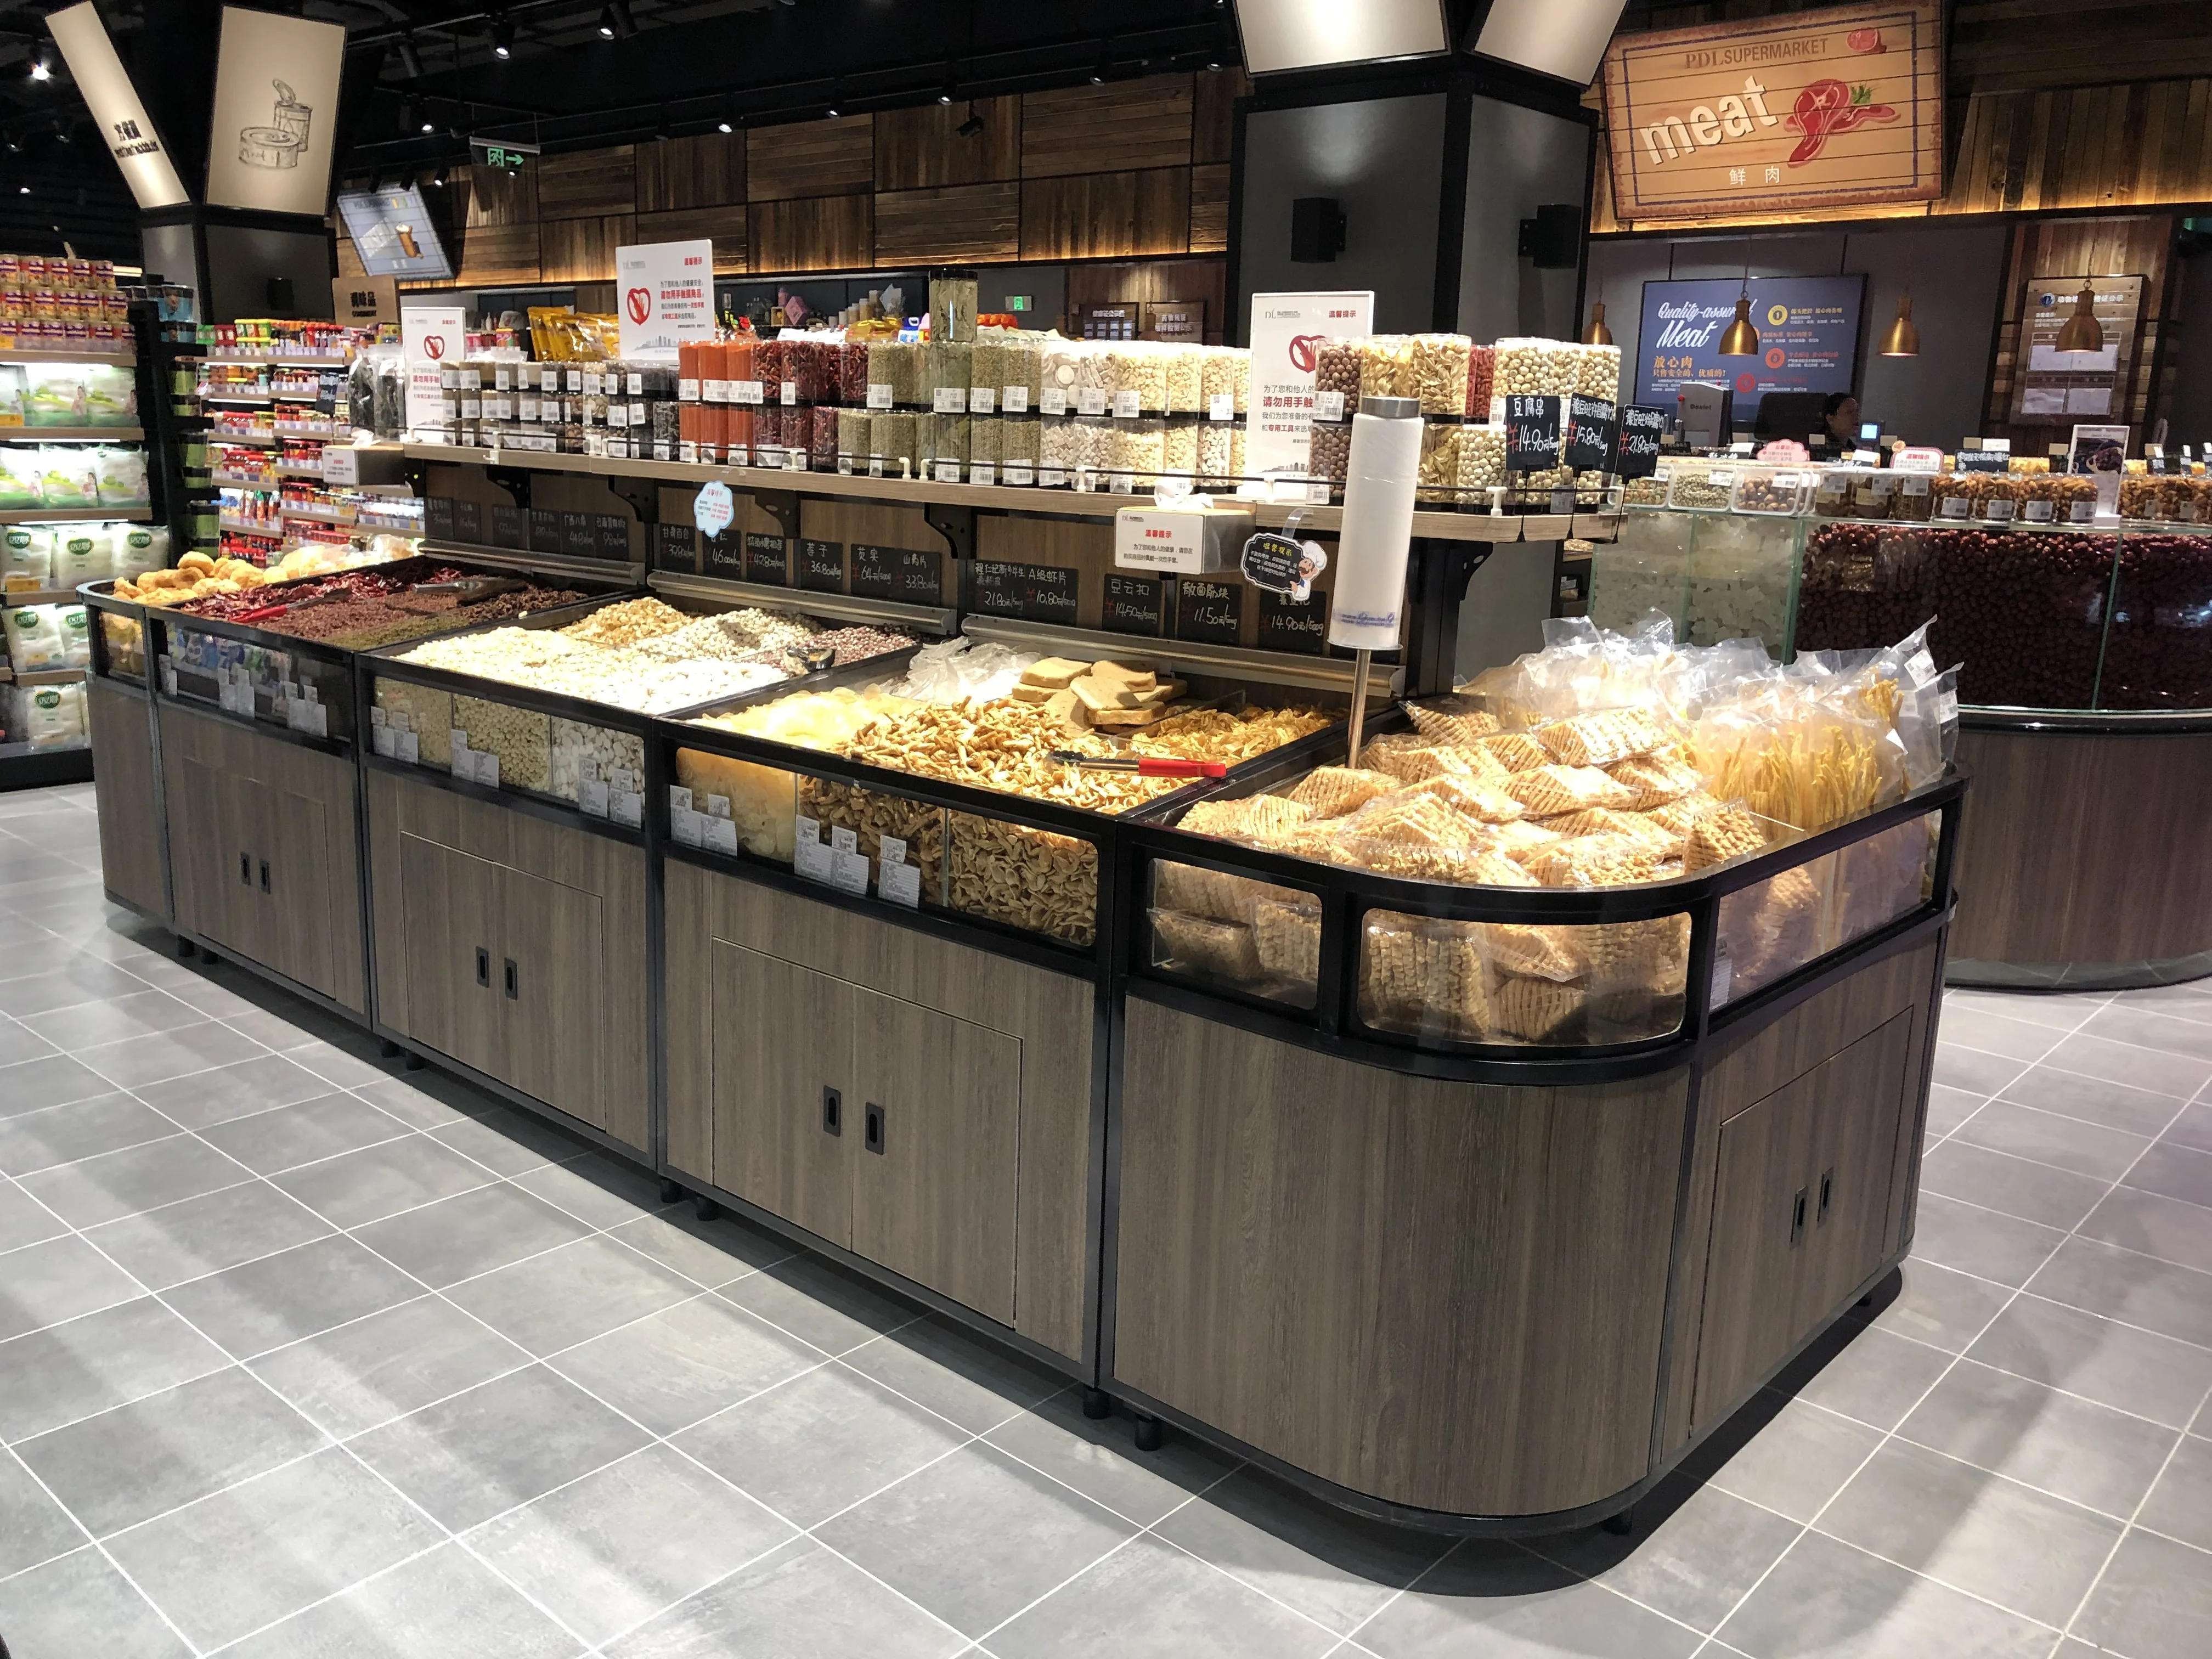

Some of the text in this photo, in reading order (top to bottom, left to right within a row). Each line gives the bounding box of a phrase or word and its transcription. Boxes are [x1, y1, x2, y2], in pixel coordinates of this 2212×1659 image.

[1640, 75, 1779, 165] meat
[1728, 165, 1781, 185] 鲜肉
[1329, 310, 1356, 318] 温馨提示
[1656, 320, 1718, 348] Meat
[1654, 356, 1693, 368] 放心肉
[1263, 385, 1314, 393] 为了您和他人的
[1263, 396, 1313, 408] 请勿用手触
[1513, 396, 1544, 418] 豆腐串
[1028, 568, 1066, 585] A级虾片
